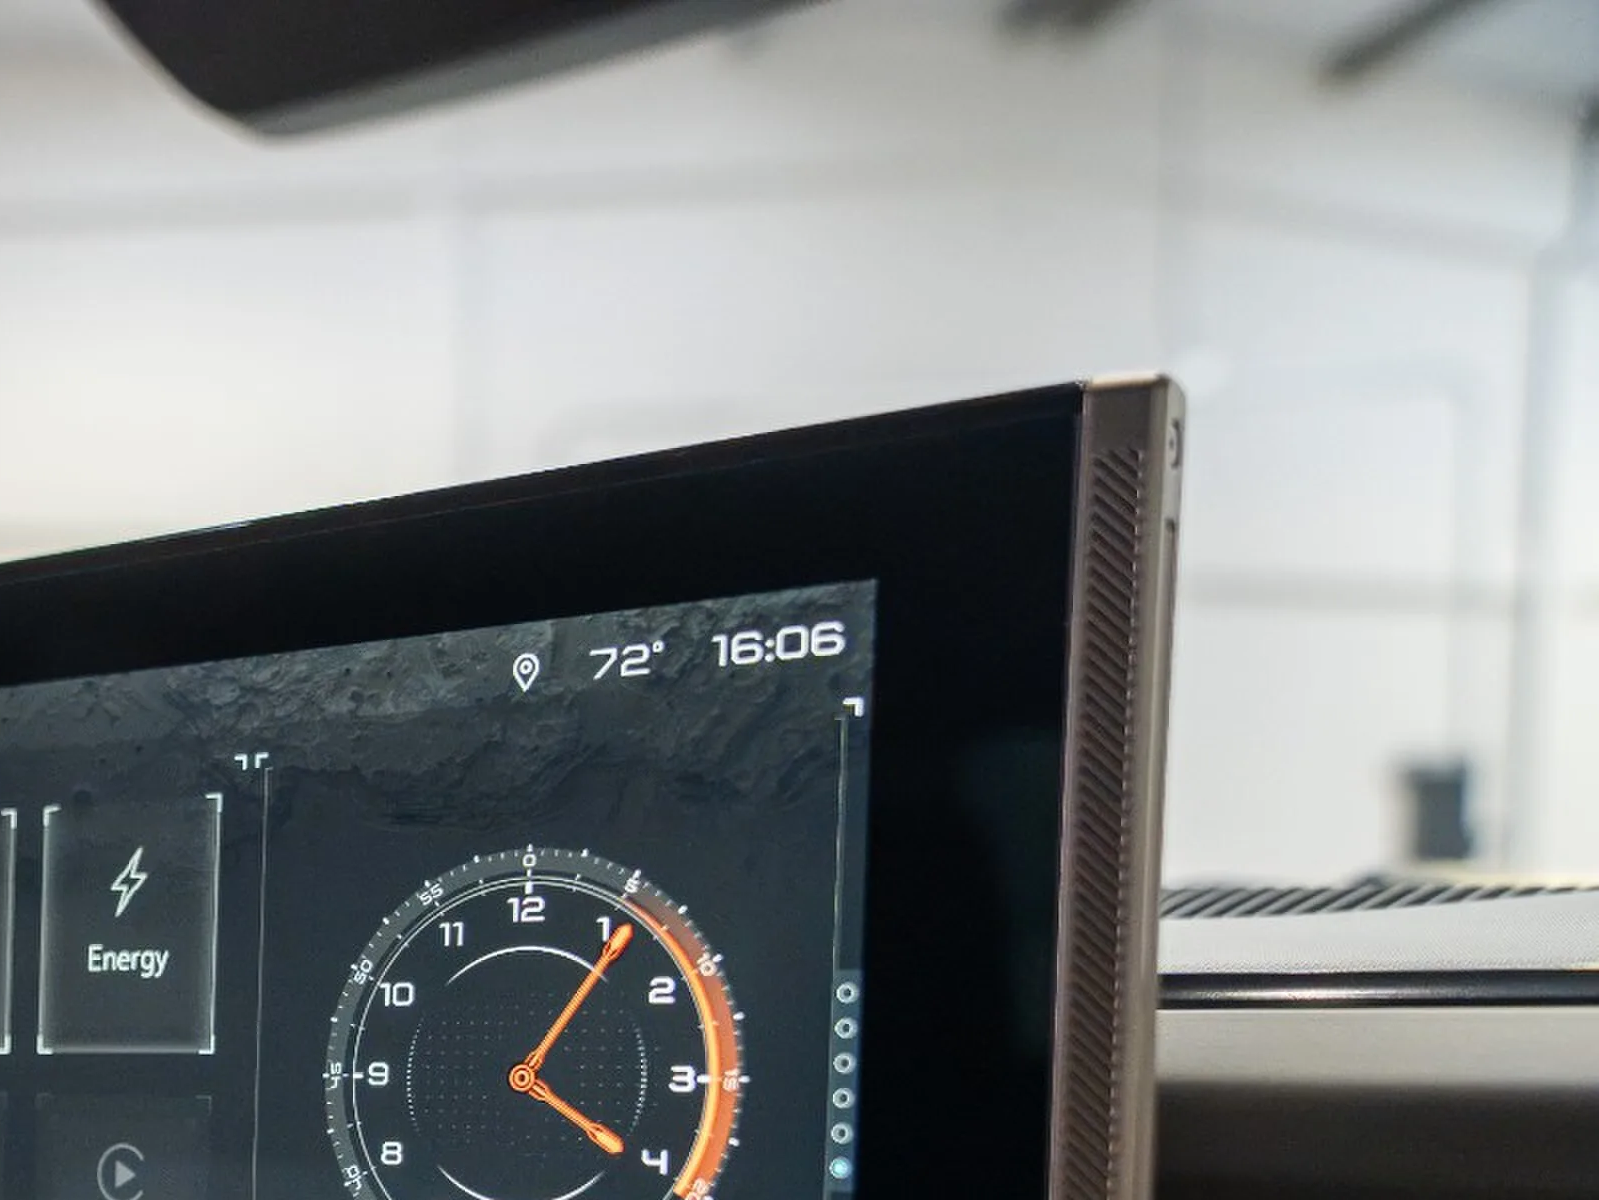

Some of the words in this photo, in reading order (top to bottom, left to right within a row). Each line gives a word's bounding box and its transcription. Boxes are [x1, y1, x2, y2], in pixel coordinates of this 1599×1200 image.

[589, 640, 664, 680] 72°
[712, 621, 846, 667] 16:06
[522, 853, 537, 868] 0
[419, 883, 443, 905] 55
[507, 897, 546, 923] 12
[439, 921, 464, 947] 11
[596, 916, 611, 942] 1
[87, 943, 169, 979] Energy
[353, 959, 374, 985] 50
[696, 951, 717, 977] 10
[380, 981, 415, 1007] 10
[648, 975, 676, 1005] 2
[368, 1061, 389, 1086] 9
[668, 1065, 696, 1093] 3
[381, 1141, 403, 1166] 8
[641, 1149, 669, 1176] 4
